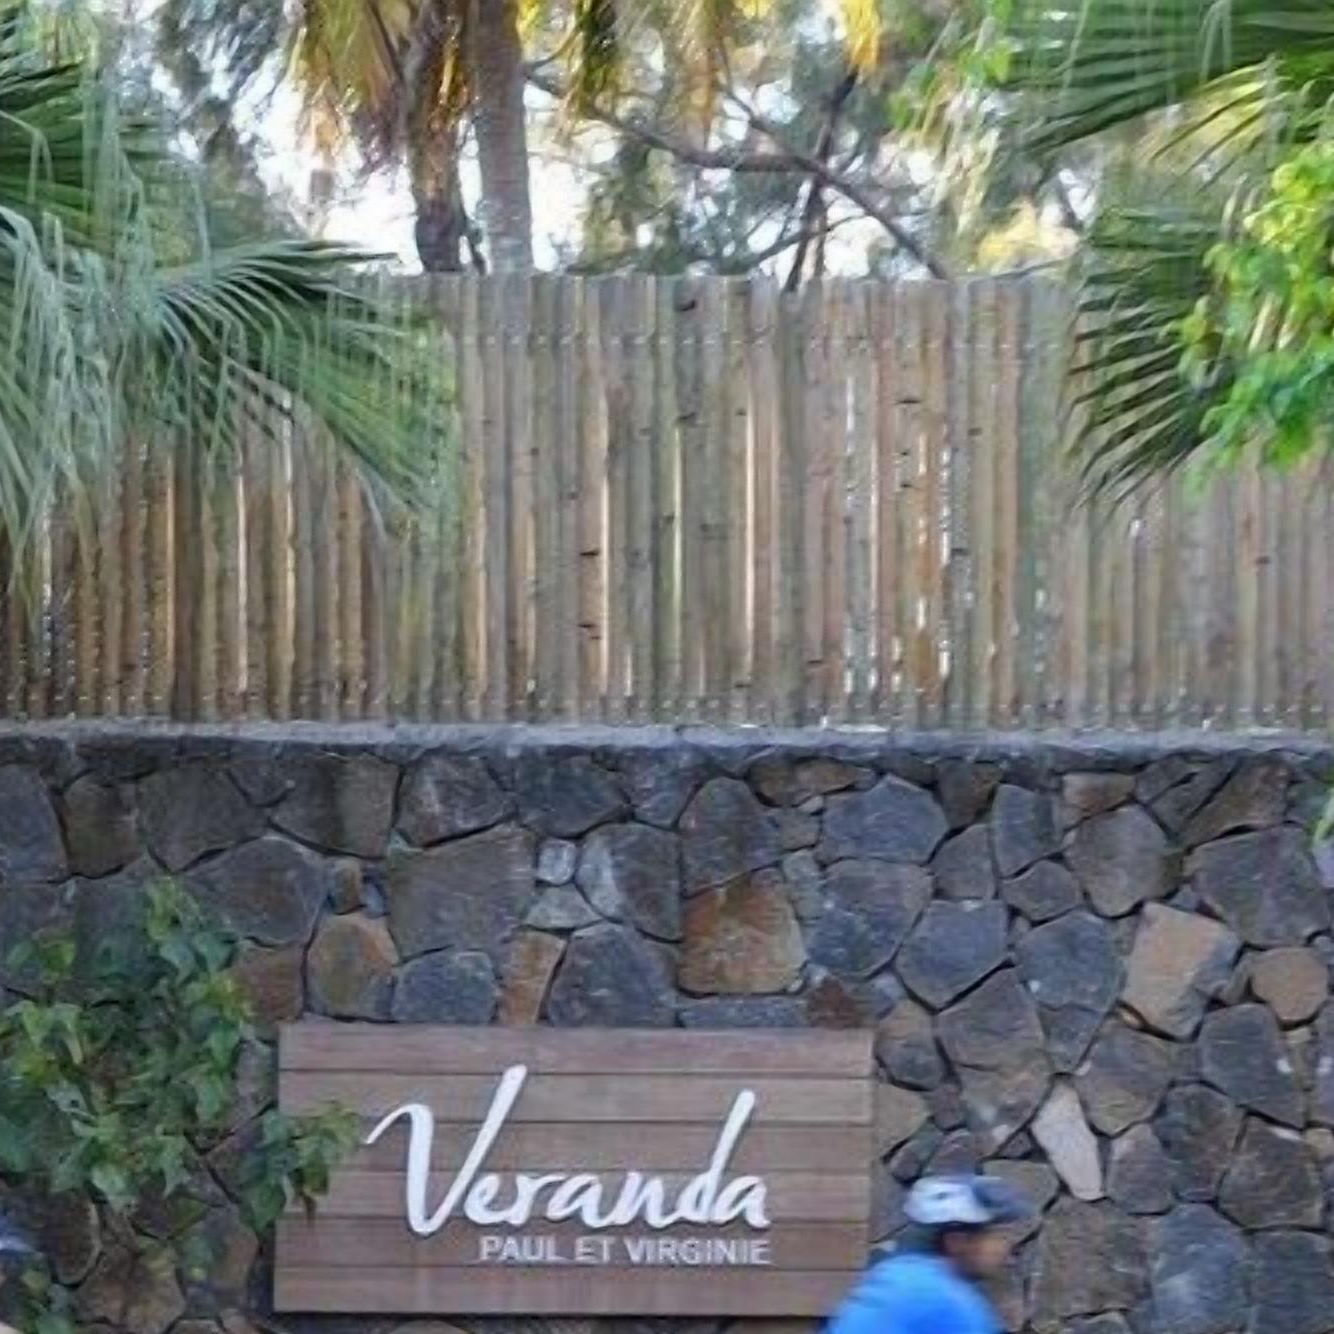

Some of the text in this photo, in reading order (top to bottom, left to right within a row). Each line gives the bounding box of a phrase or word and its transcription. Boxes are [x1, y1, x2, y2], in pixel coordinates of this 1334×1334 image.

[365, 1064, 770, 1235] Veranda
[480, 1235, 770, 1264] PAUL ET VIRGINIE
